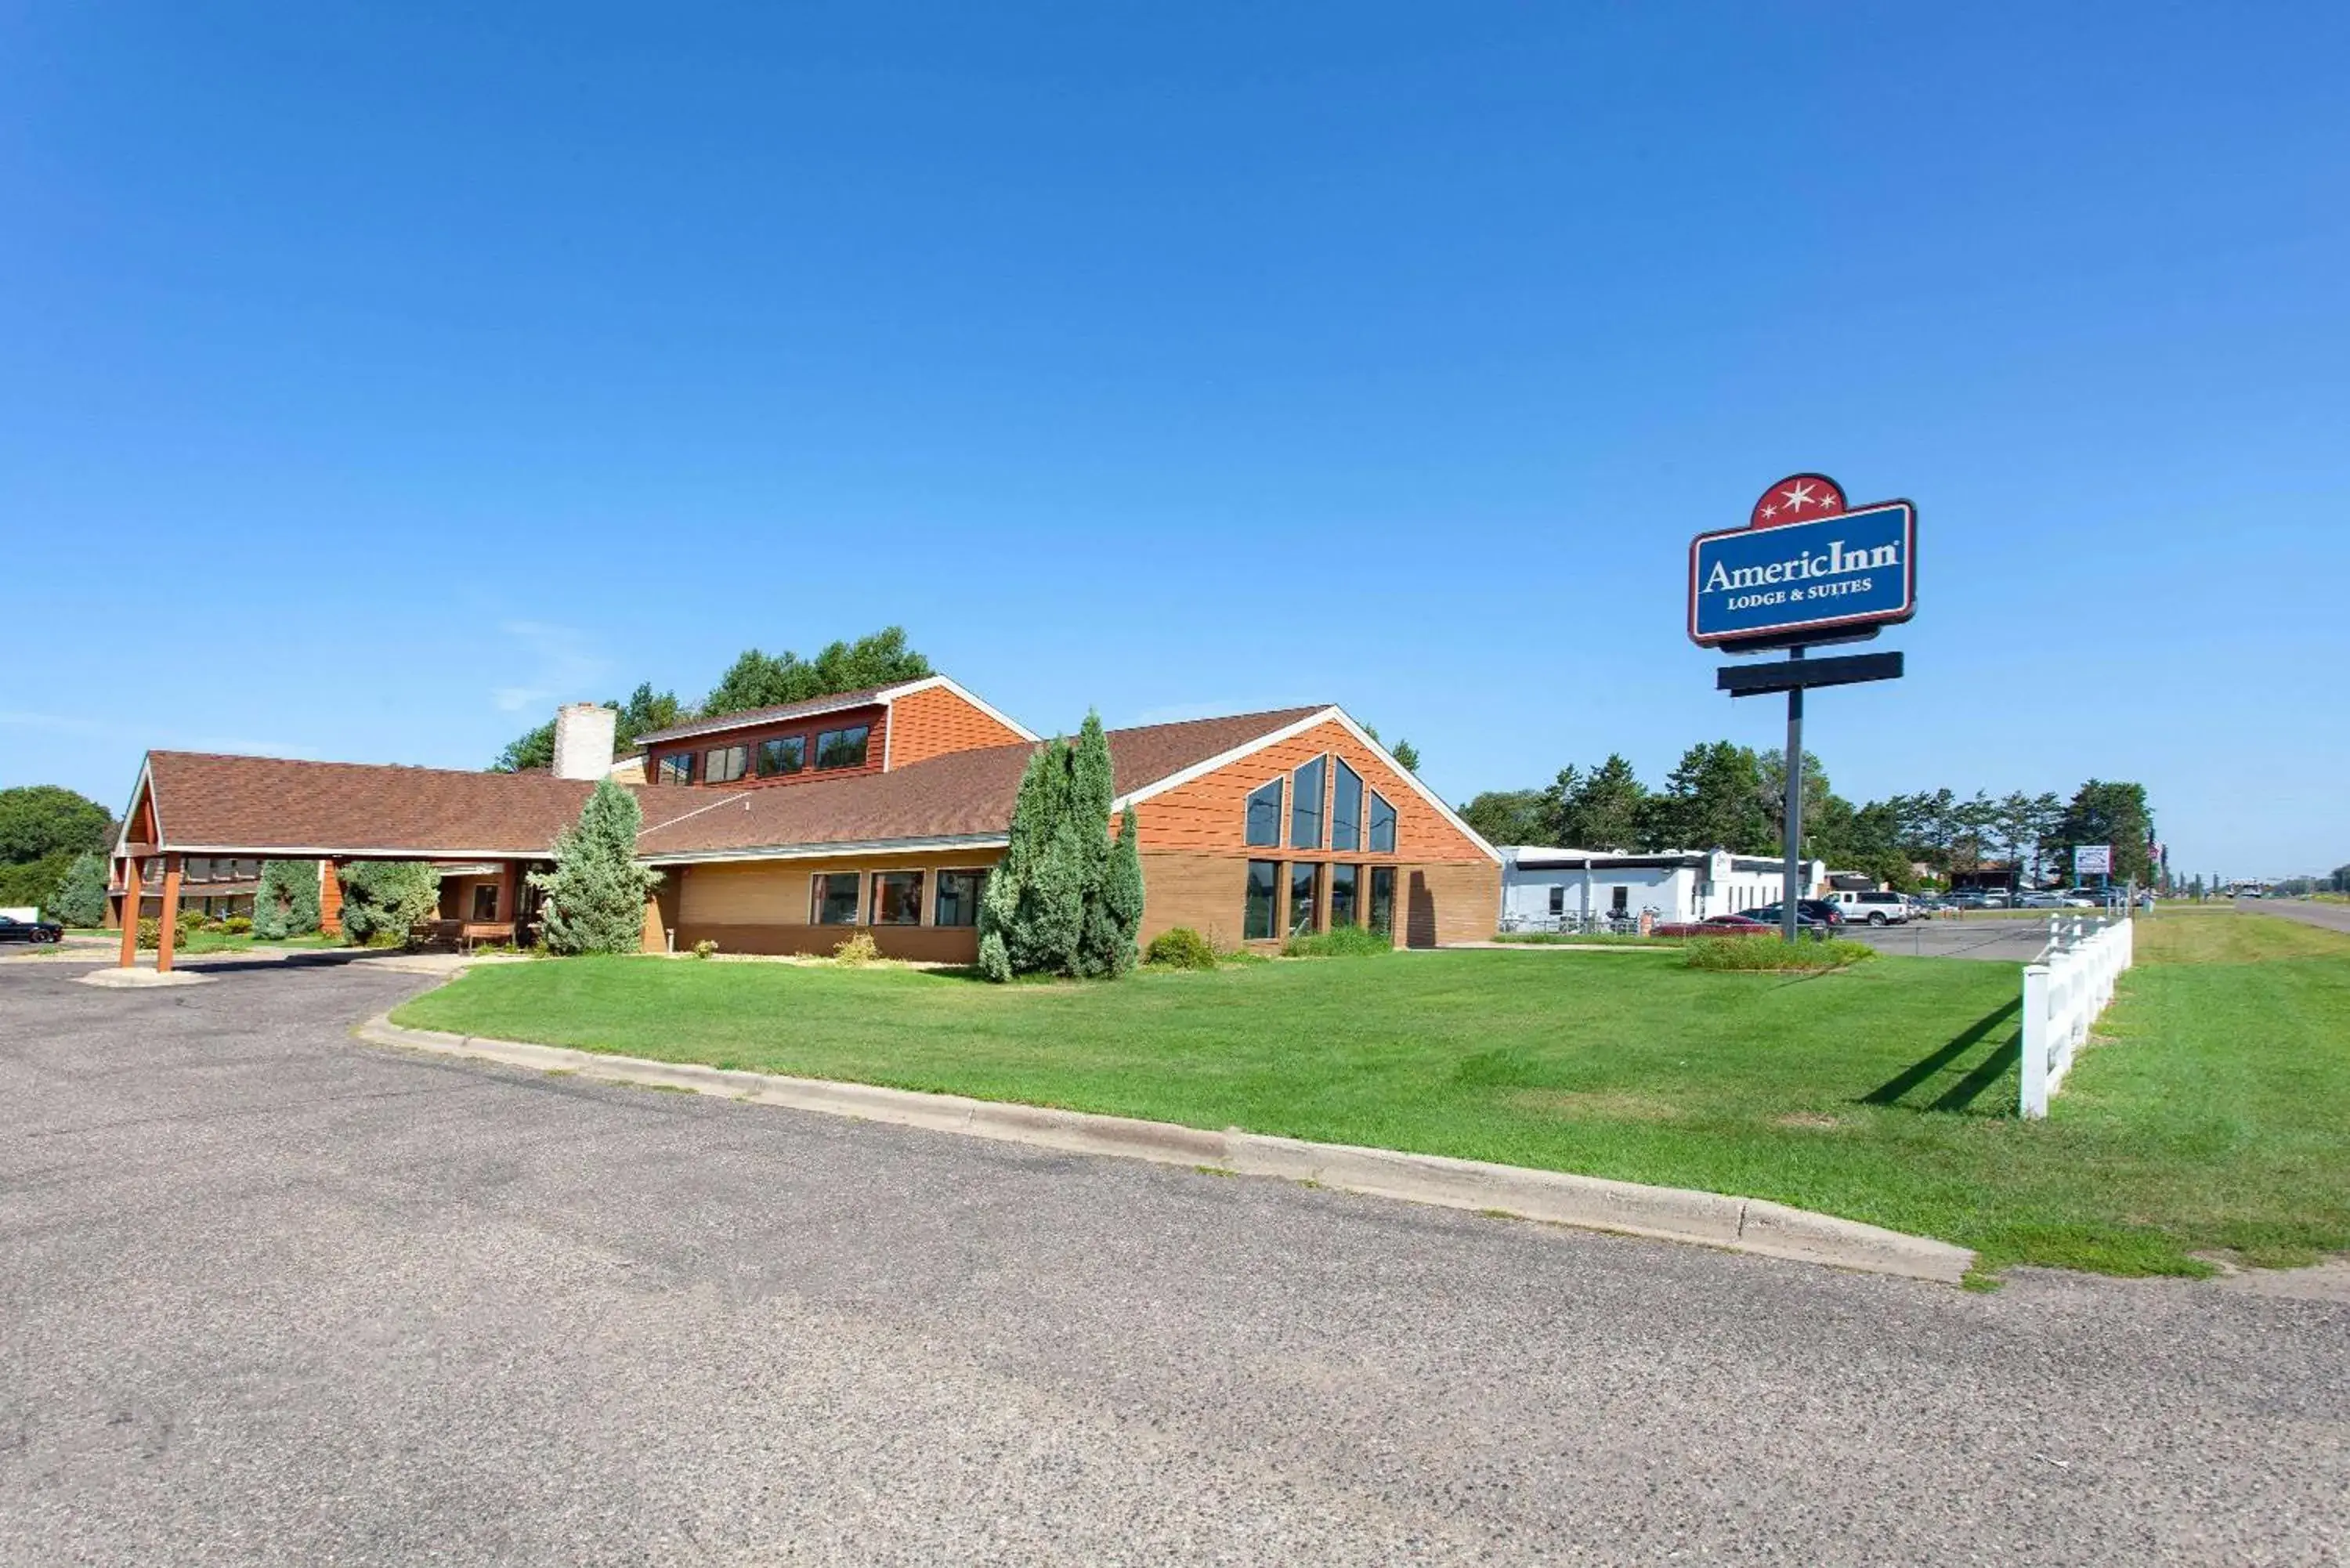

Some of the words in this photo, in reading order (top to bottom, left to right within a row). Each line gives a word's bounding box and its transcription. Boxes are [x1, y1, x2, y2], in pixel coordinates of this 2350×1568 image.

[1702, 540, 1900, 593] AmericInn
[1726, 591, 1786, 610] LODGE
[1790, 588, 1804, 602] &
[1808, 577, 1872, 599] SUITES
